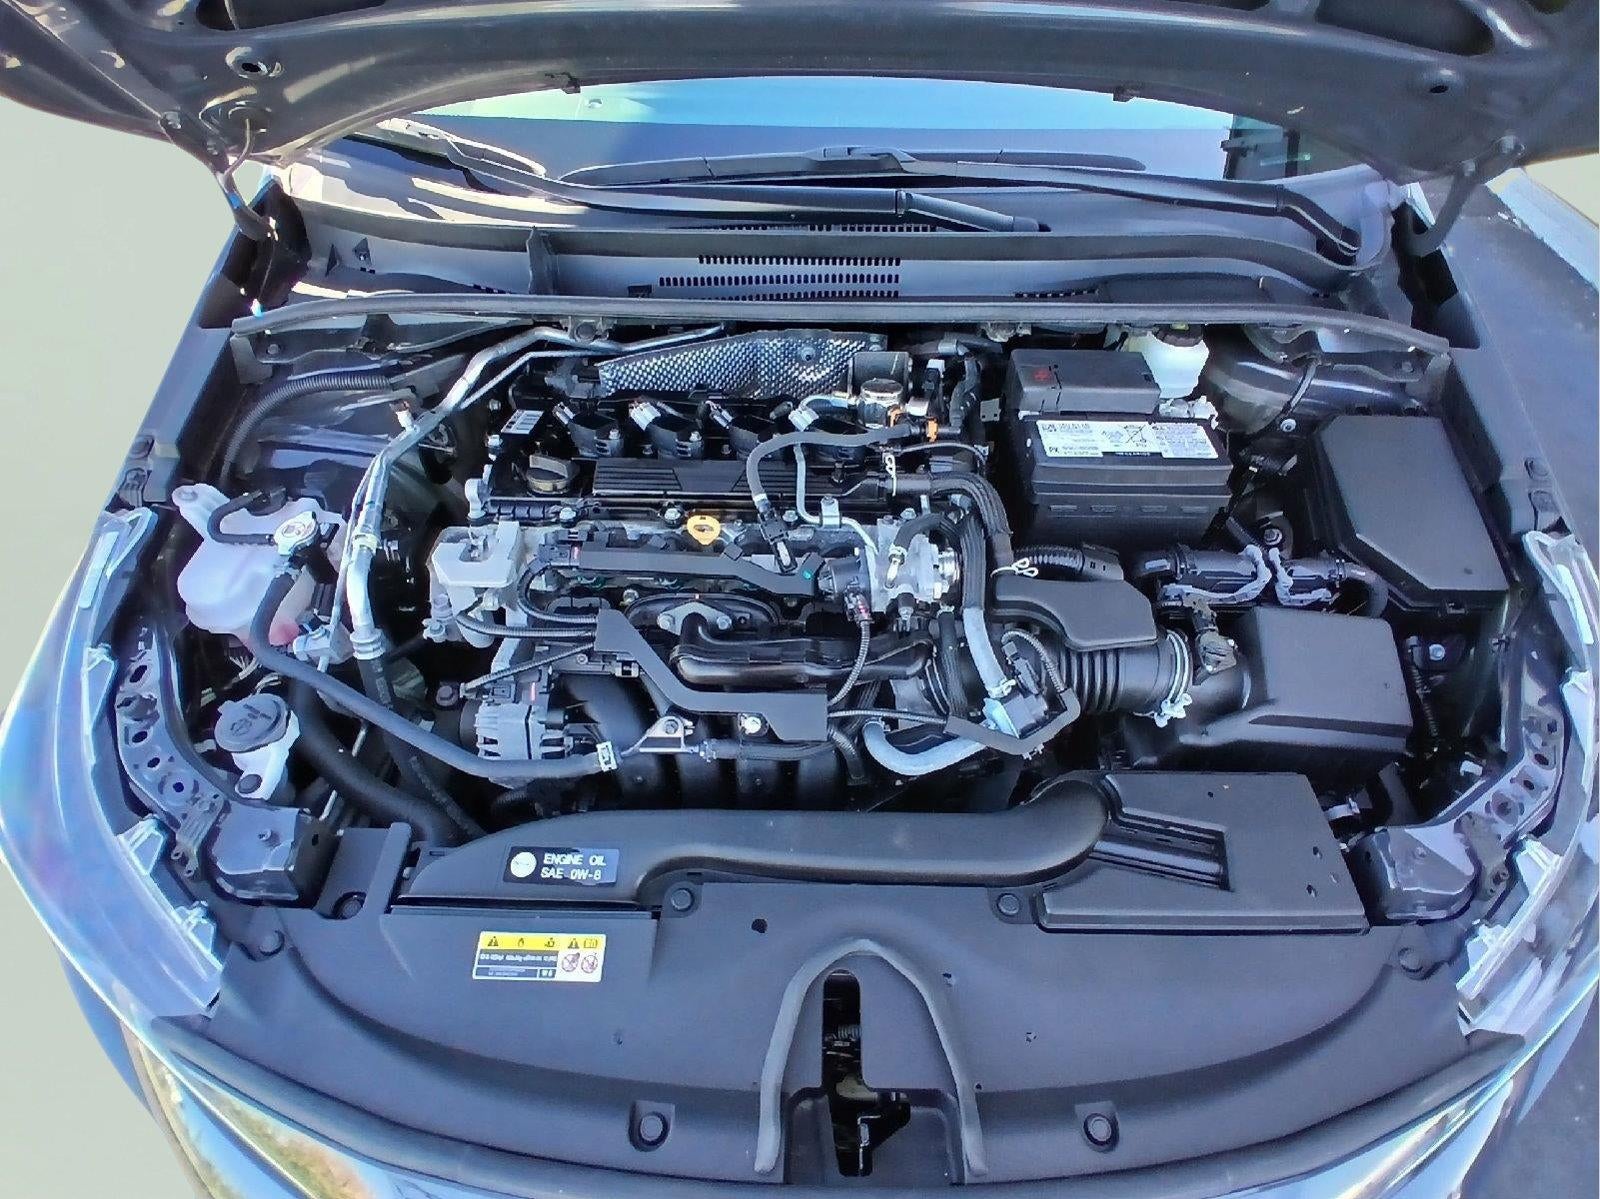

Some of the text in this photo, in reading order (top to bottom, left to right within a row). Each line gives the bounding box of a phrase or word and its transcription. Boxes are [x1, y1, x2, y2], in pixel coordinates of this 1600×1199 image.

[543, 852, 607, 866] ENGINE OIL
[540, 867, 565, 879] SAE
